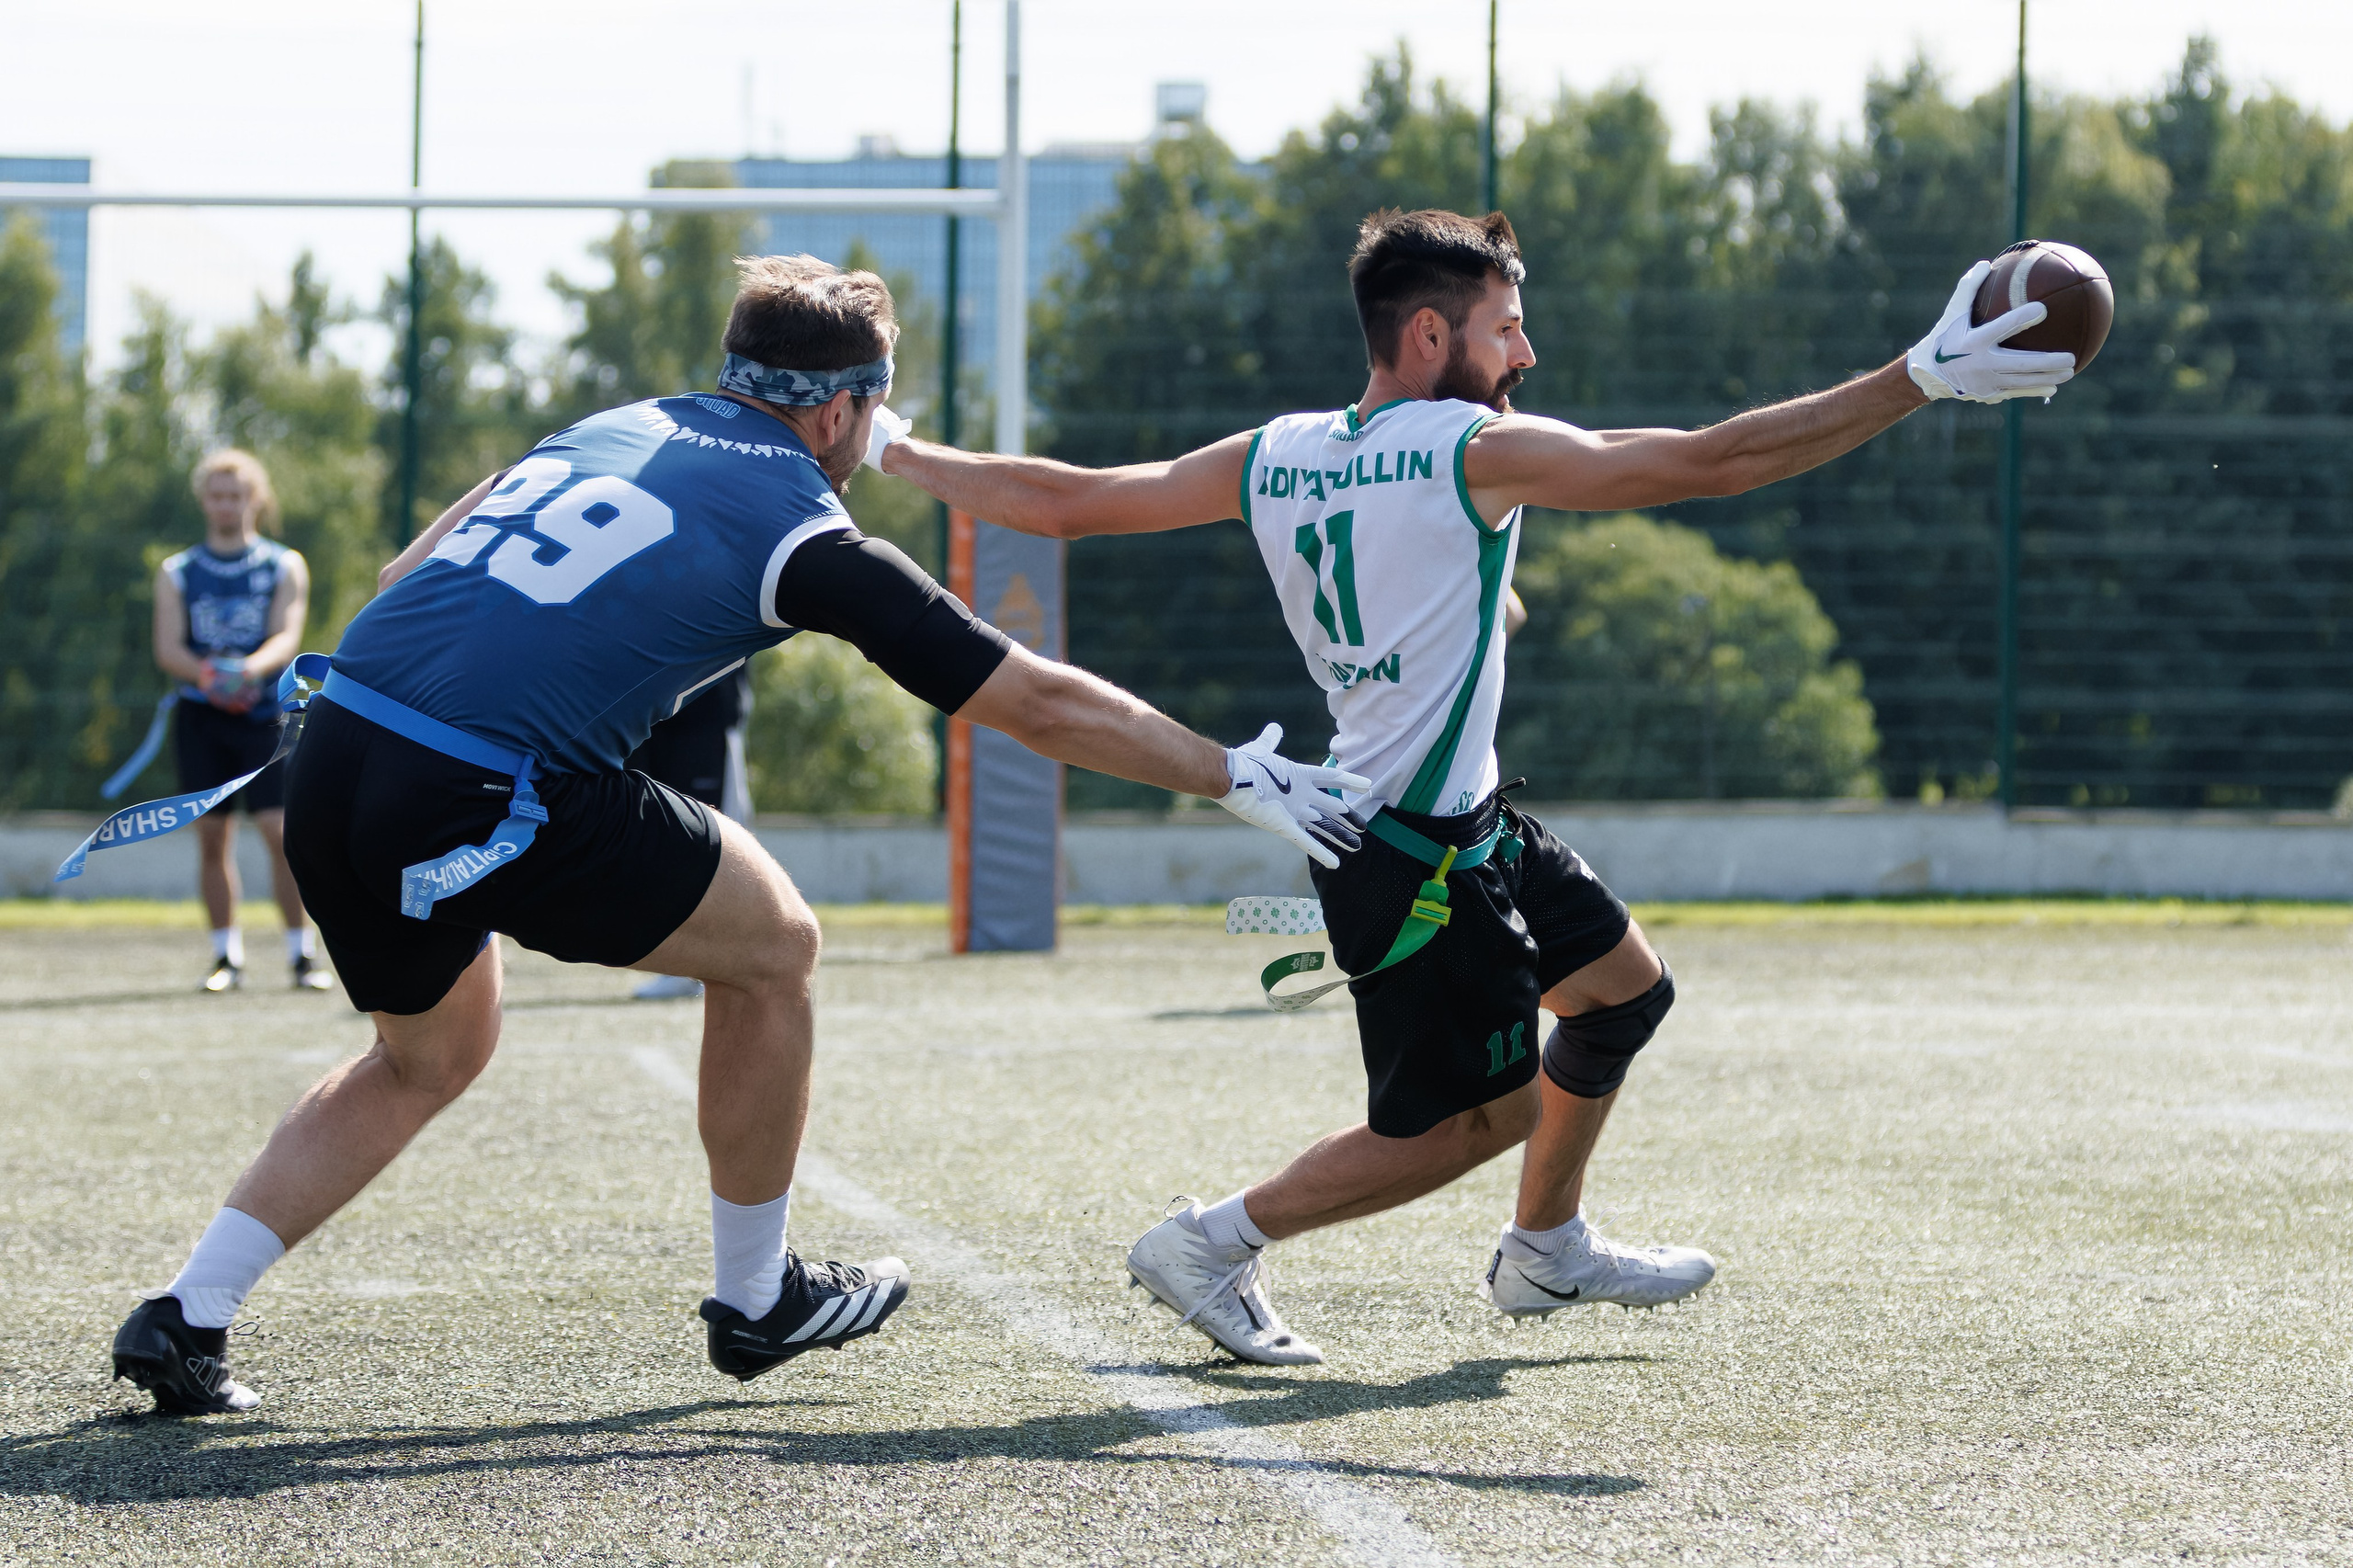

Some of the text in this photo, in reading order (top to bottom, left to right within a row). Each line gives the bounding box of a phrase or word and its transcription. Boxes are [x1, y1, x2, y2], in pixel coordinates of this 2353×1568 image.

[428, 458, 676, 606] 29
[1295, 509, 1365, 646] 11
[1486, 1020, 1527, 1077] 11
